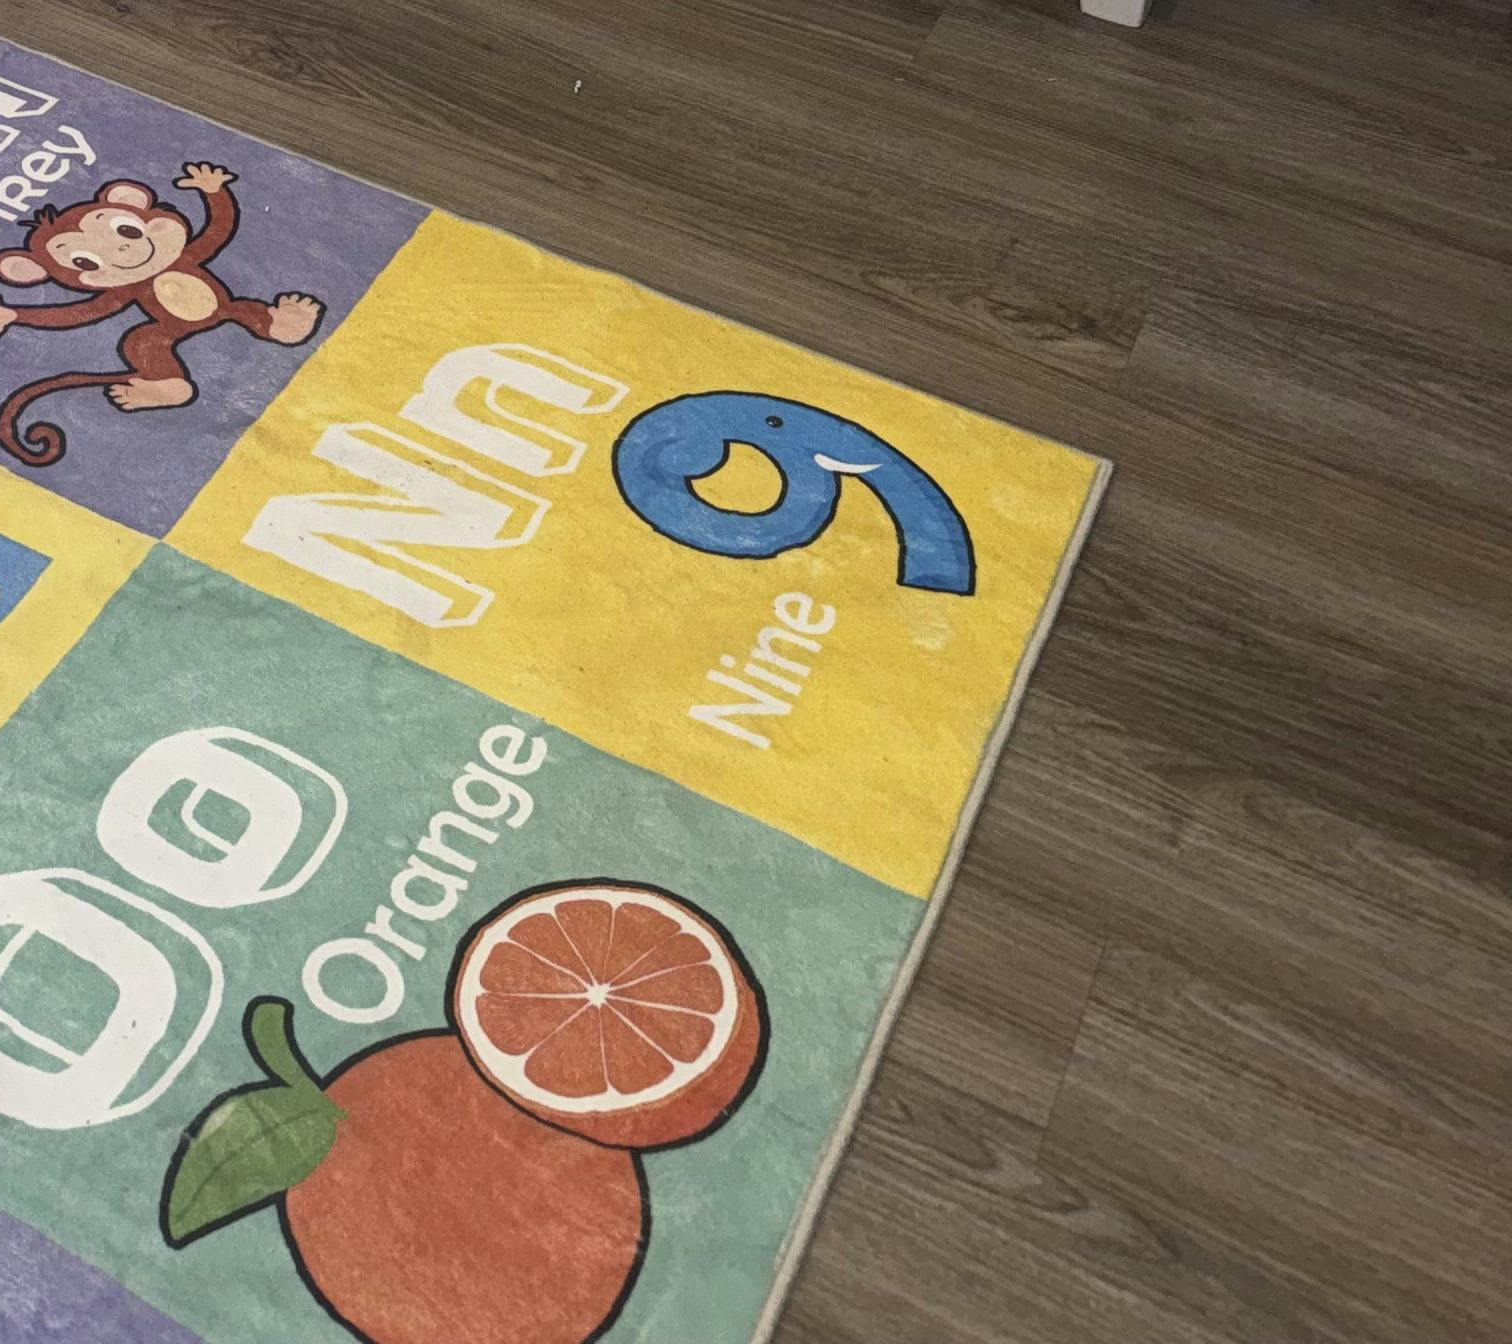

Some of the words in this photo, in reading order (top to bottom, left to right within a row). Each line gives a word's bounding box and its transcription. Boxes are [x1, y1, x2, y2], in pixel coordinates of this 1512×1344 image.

[242, 342, 630, 629] Nn
[689, 590, 836, 750] Nine
[302, 722, 548, 1024] Orange
